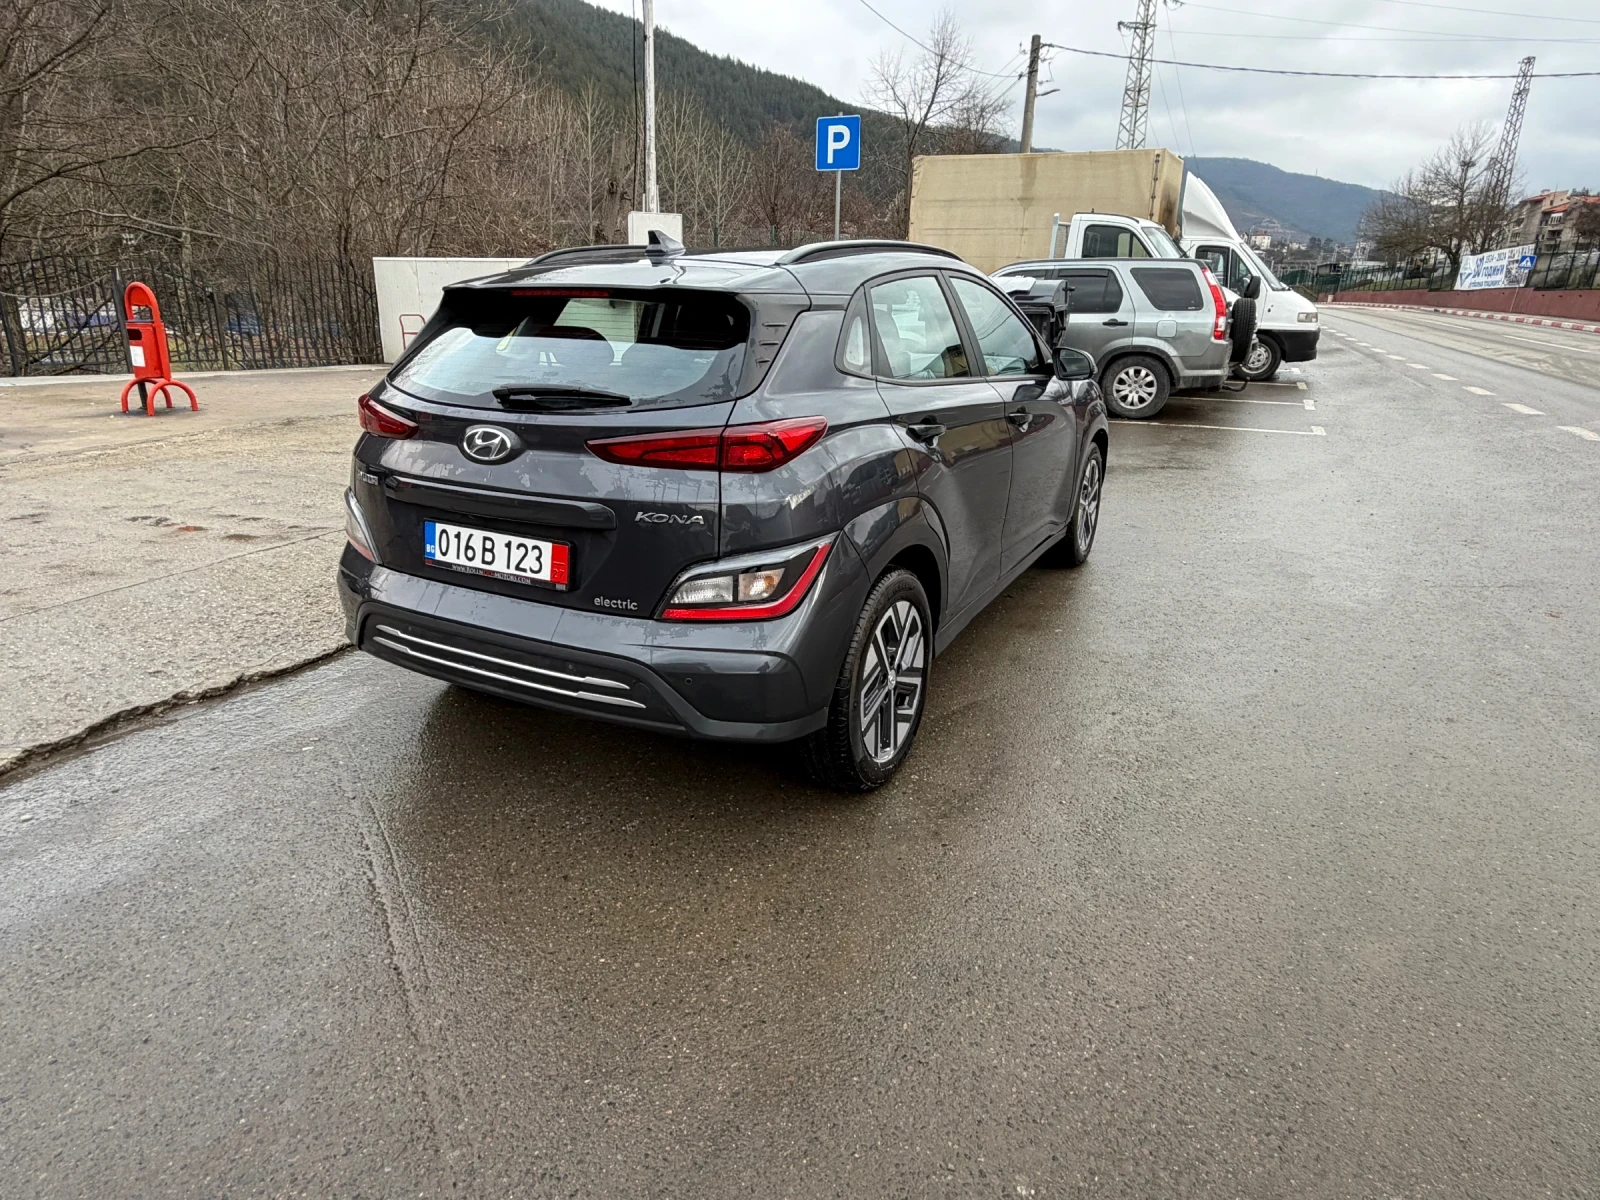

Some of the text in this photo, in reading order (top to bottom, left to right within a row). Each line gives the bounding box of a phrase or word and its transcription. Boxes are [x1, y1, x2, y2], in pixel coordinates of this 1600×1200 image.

[827, 125, 850, 164] P
[634, 511, 705, 525] KONA
[426, 544, 435, 553] BG
[594, 596, 638, 611] electric
